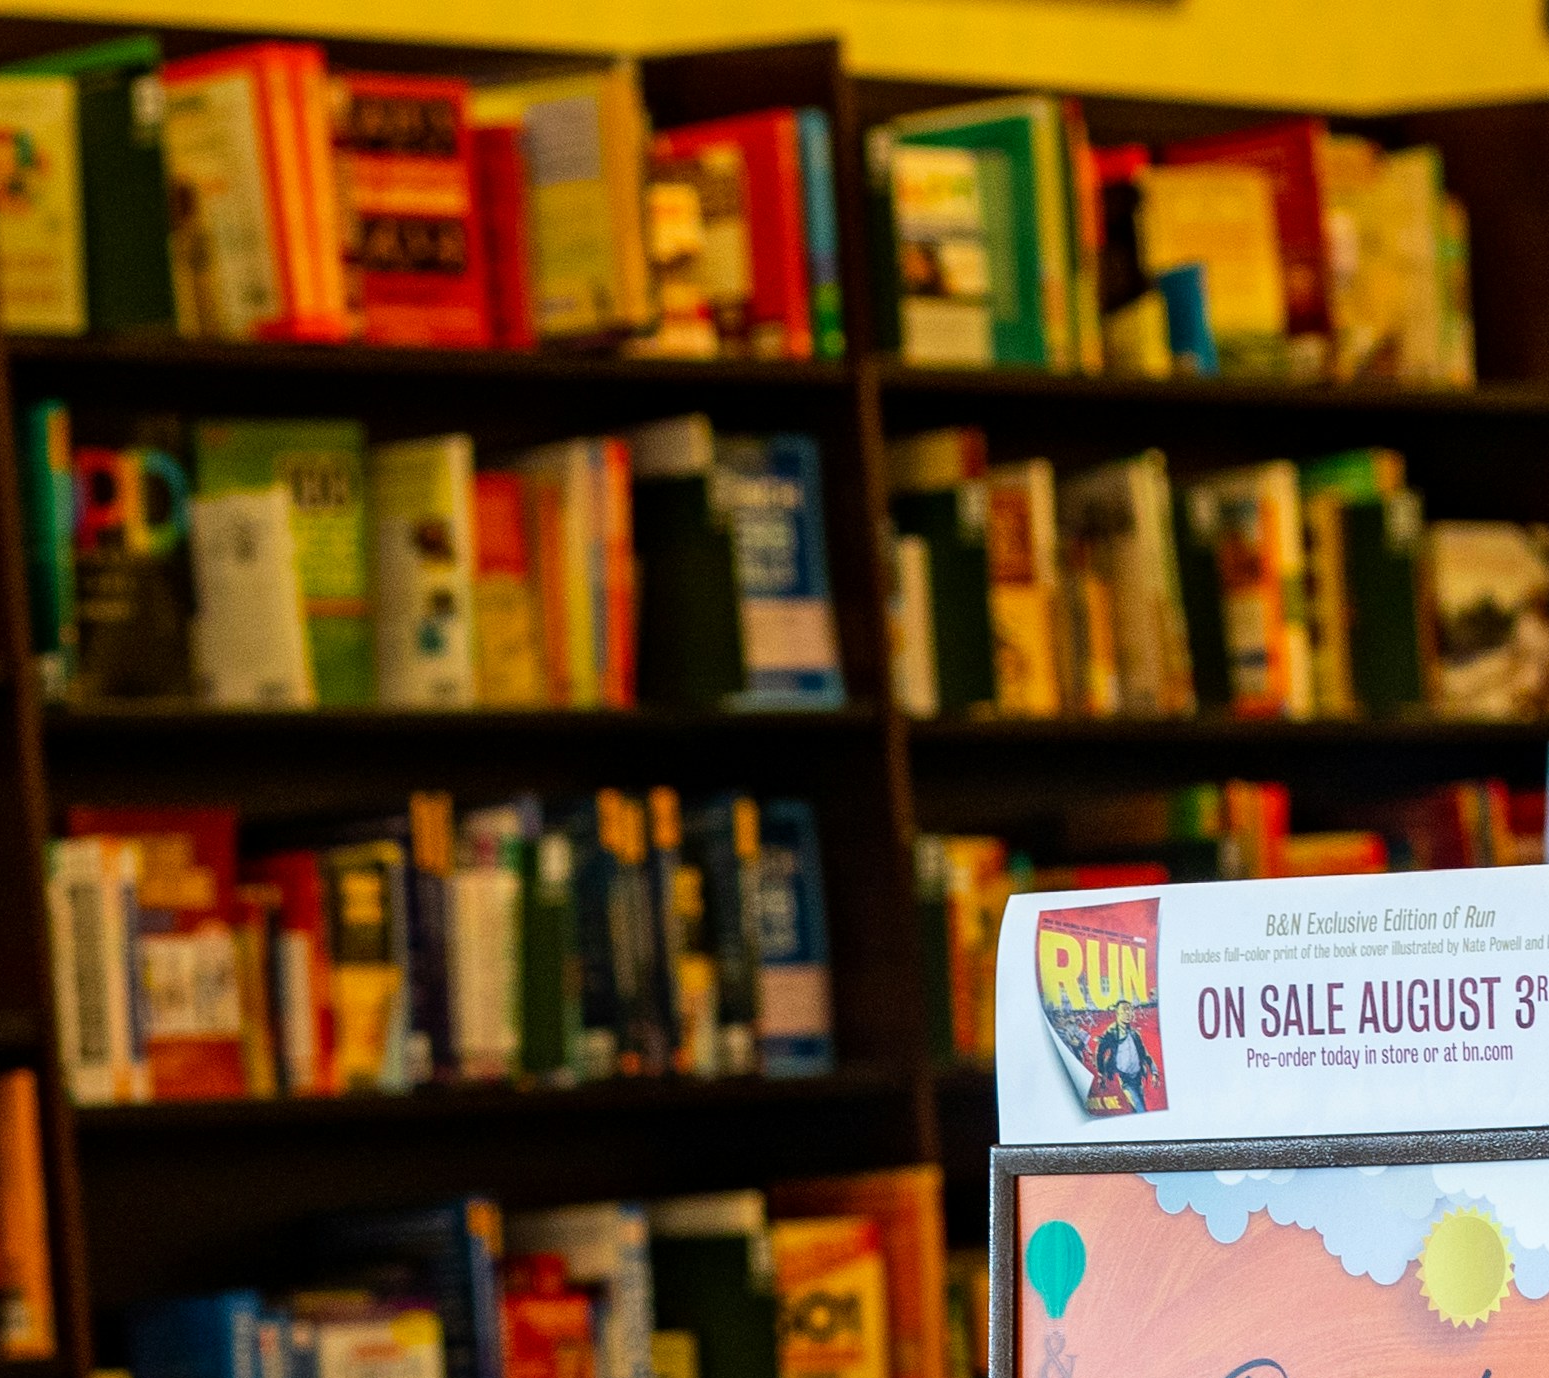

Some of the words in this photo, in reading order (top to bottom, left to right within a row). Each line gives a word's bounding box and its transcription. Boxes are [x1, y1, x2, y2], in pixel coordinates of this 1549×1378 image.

[1266, 912, 1301, 937] B&N
[1307, 909, 1377, 935] Exclusive
[1384, 908, 1437, 931] Edition
[1443, 907, 1461, 930] of
[1465, 905, 1496, 929] Run
[1180, 950, 1221, 964] Includes
[1224, 947, 1269, 963] full-color
[1273, 947, 1297, 964] print
[1301, 945, 1312, 960] of
[1314, 944, 1330, 958] the
[1334, 943, 1357, 958] book
[1360, 944, 1388, 957] cover
[1392, 939, 1444, 955] illustrated
[1447, 939, 1459, 956] by
[1462, 938, 1486, 952] Nate
[1489, 936, 1522, 951] Powell
[1525, 935, 1543, 950] and
[1039, 928, 1149, 1012] RUN
[1198, 986, 1245, 1040] ON
[1260, 982, 1346, 1038] SALE
[1358, 976, 1501, 1034] AUGUST
[1247, 1049, 1316, 1069] Pre-order
[1321, 1047, 1359, 1070] today
[1365, 1045, 1377, 1064] in
[1381, 1045, 1419, 1064] store
[1424, 1047, 1439, 1063] or
[1444, 1044, 1458, 1062] at
[1462, 1041, 1513, 1061] bn.com
